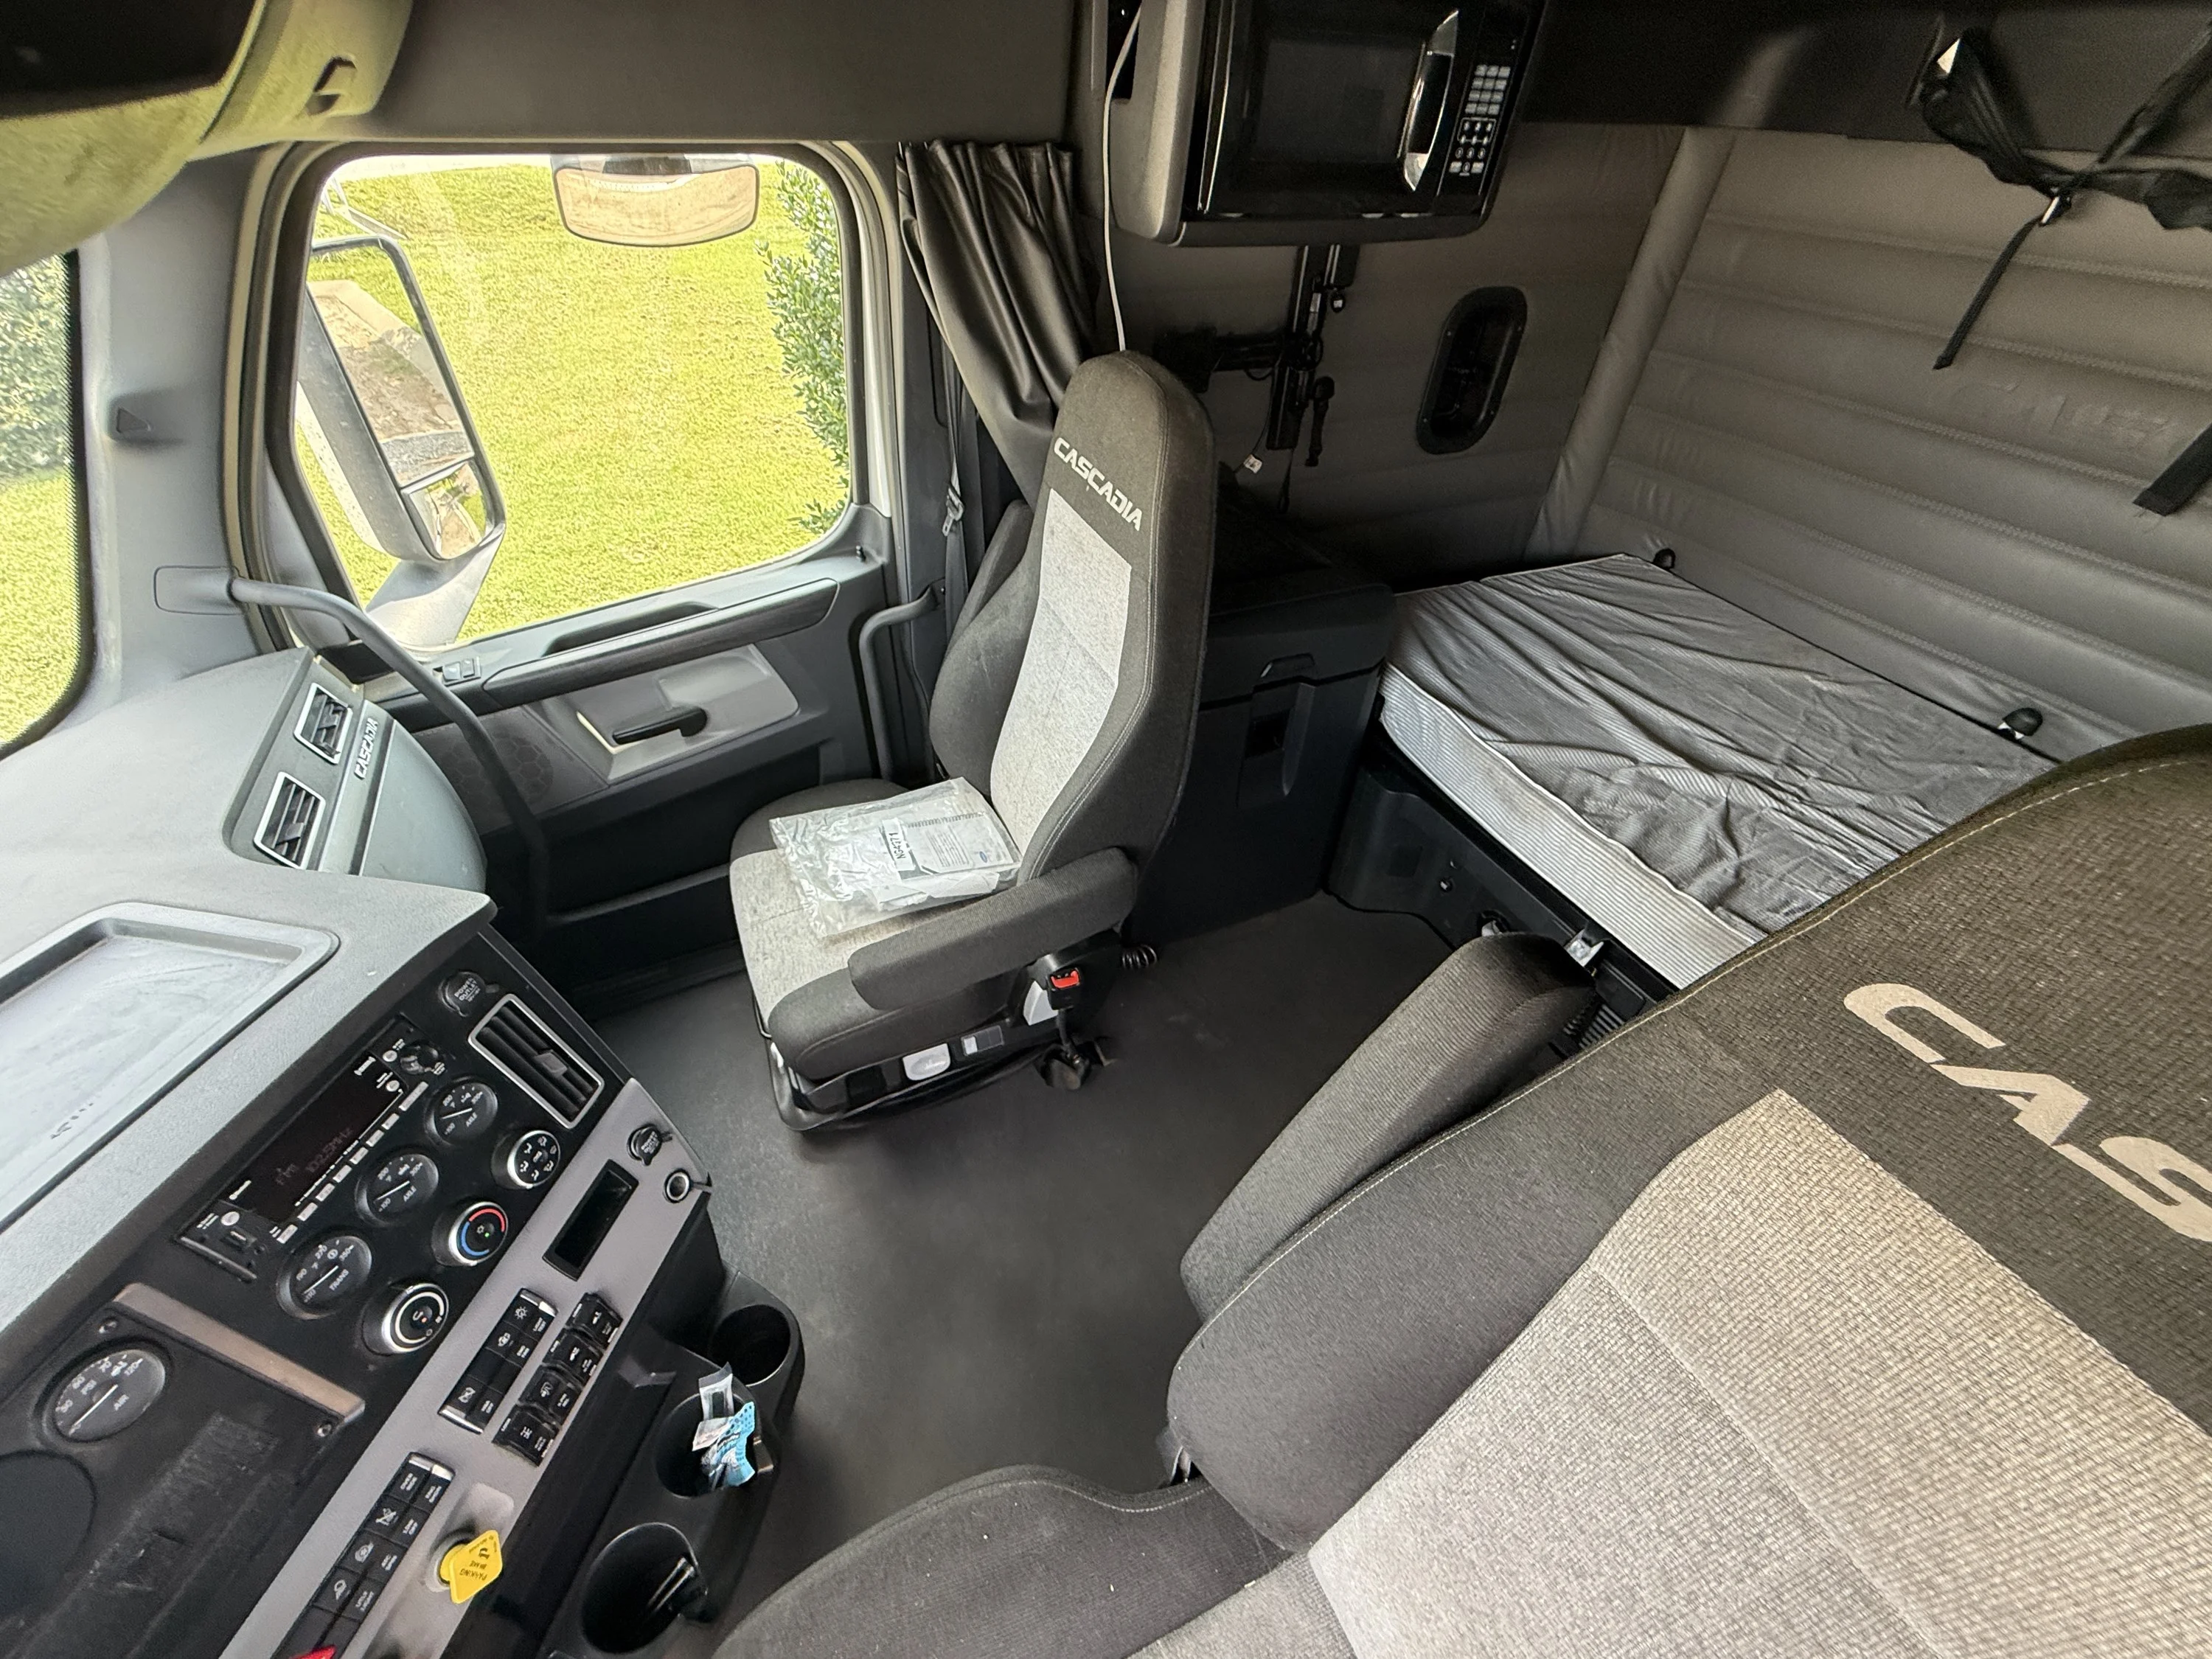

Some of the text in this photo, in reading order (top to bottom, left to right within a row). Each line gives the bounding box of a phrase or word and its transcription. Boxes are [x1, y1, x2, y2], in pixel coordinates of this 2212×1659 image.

[1054, 437, 1143, 531] CASCADIA
[354, 717, 378, 779] CASCADIA
[465, 1112, 478, 1127] AXLE
[403, 1186, 417, 1203] AXLE
[315, 1245, 328, 1260] 270
[339, 1247, 352, 1262] 350
[329, 1268, 349, 1291] TRANS
[124, 1361, 140, 1377] 120
[114, 1394, 130, 1411] AIR
[459, 1568, 488, 1581] PARKING
